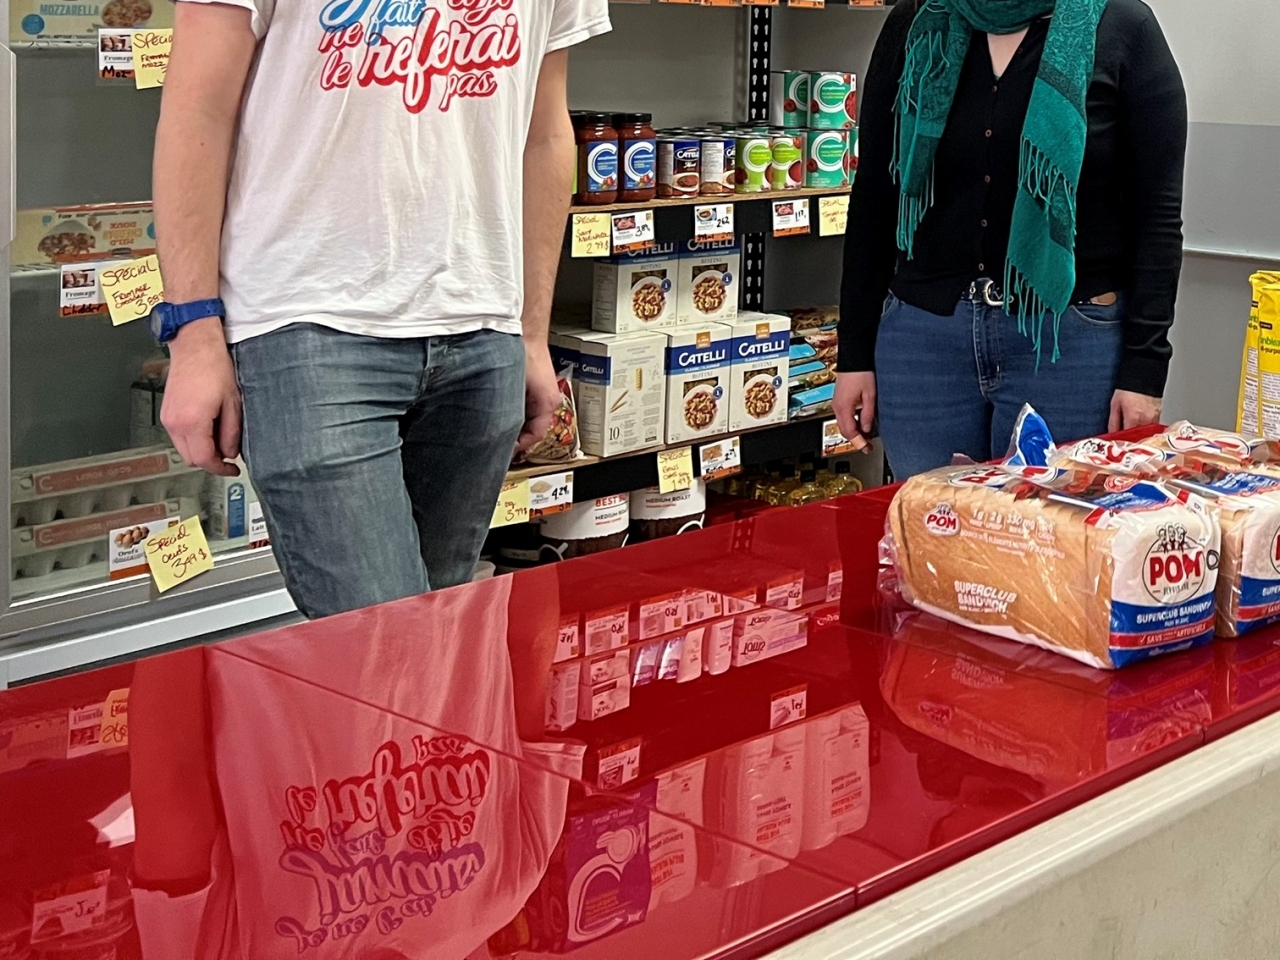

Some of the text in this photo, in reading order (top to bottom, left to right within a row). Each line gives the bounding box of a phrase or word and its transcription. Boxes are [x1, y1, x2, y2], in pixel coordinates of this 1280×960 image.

[40, 4, 99, 16] MOZZARELLA
[317, 20, 364, 54] ne
[356, 6, 521, 114] referai
[320, 49, 353, 92] le
[438, 70, 498, 112] pas
[687, 239, 735, 252] CATELLI
[738, 340, 785, 357] CATELLI
[678, 349, 726, 367] CATELLI
[608, 426, 620, 441] 10
[595, 495, 617, 507] BEST
[672, 494, 691, 502] ROAST
[926, 514, 957, 530] POM
[1149, 551, 1204, 586] POM
[953, 580, 1017, 603] SUPERCLUB
[957, 593, 1008, 613] SANDWICH
[1136, 610, 1178, 624] SUPERCLUB
